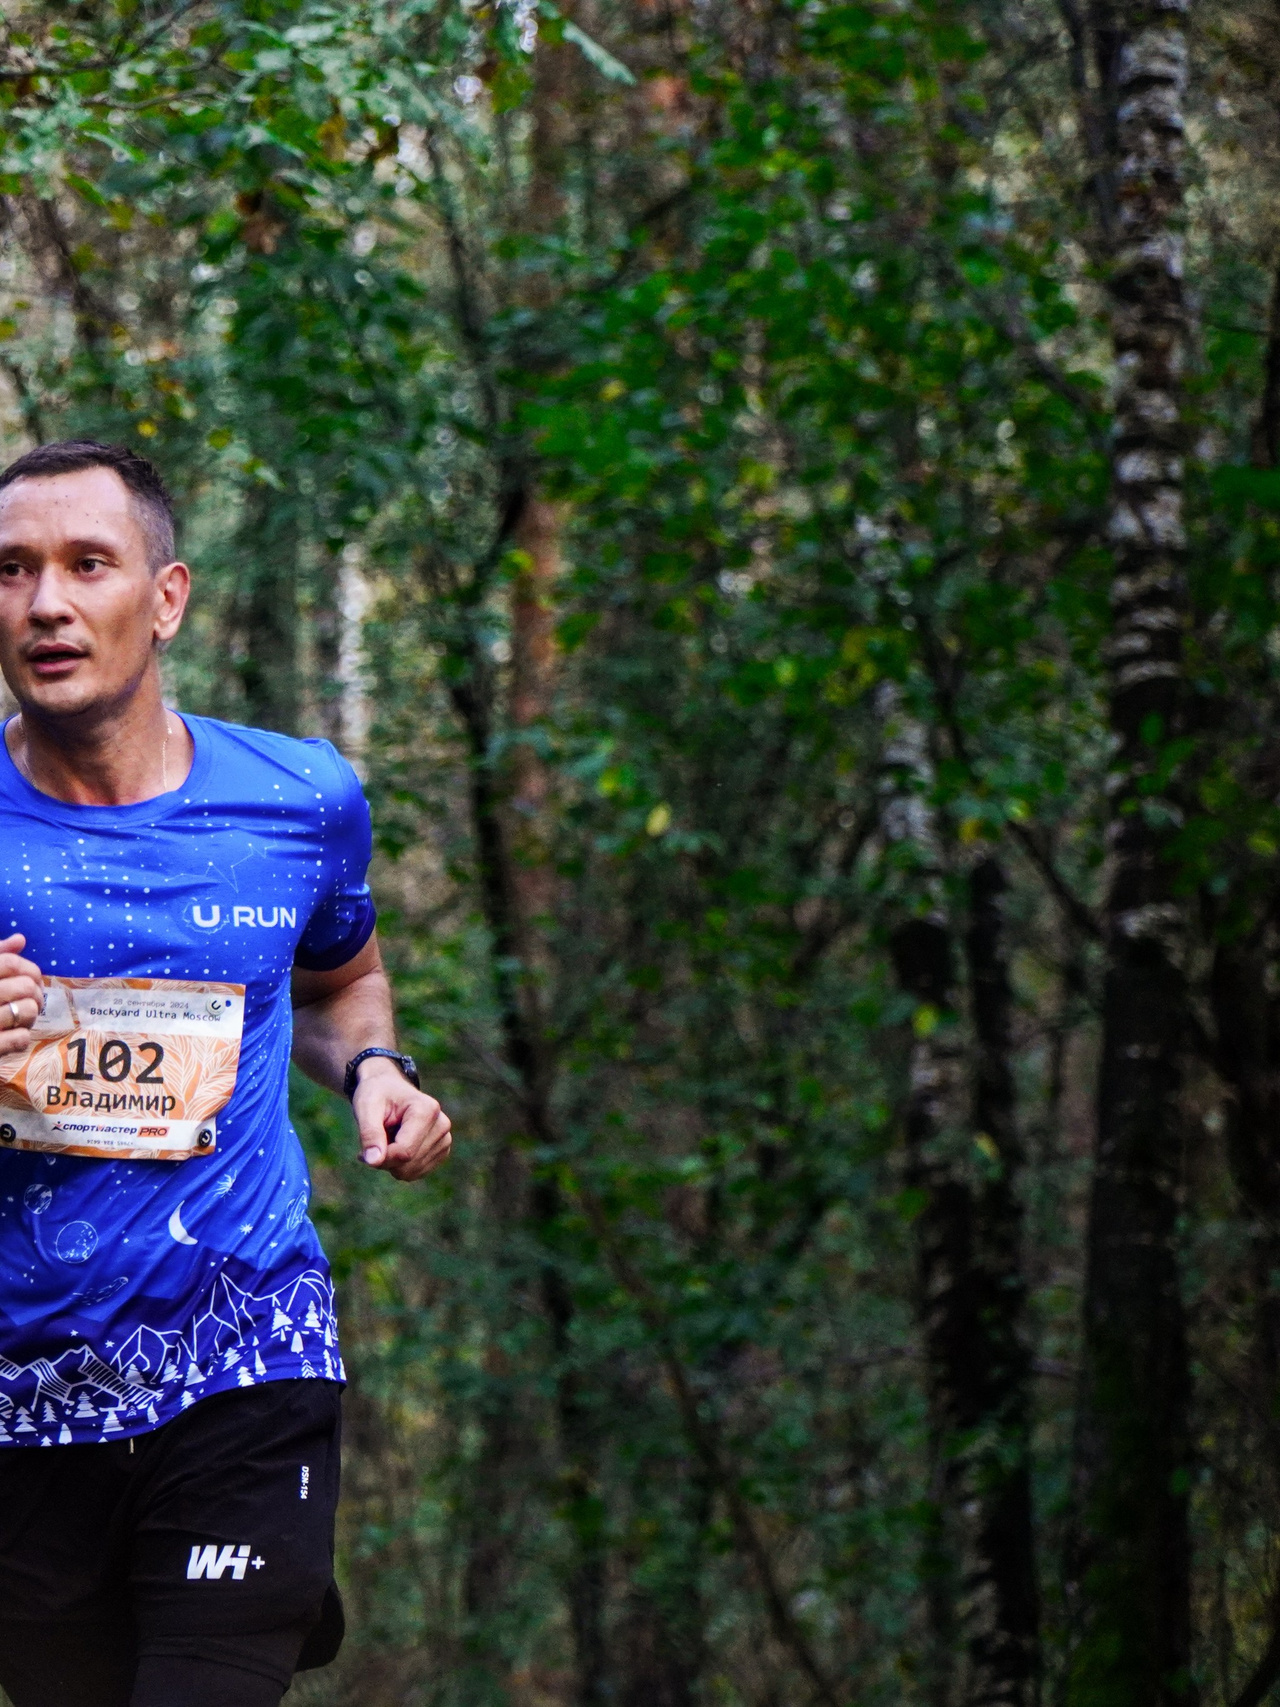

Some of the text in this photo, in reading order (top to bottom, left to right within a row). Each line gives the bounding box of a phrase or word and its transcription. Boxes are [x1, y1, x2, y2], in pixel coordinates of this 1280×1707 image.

[192, 905, 297, 928] U RUN
[126, 999, 166, 1008] сентября
[170, 1001, 189, 1009] 2024
[90, 1007, 221, 1022] Backyard Ultra Moscow
[65, 1037, 165, 1085] 102
[46, 1085, 177, 1116] Владимир
[63, 1122, 168, 1136] спортмастер PRO
